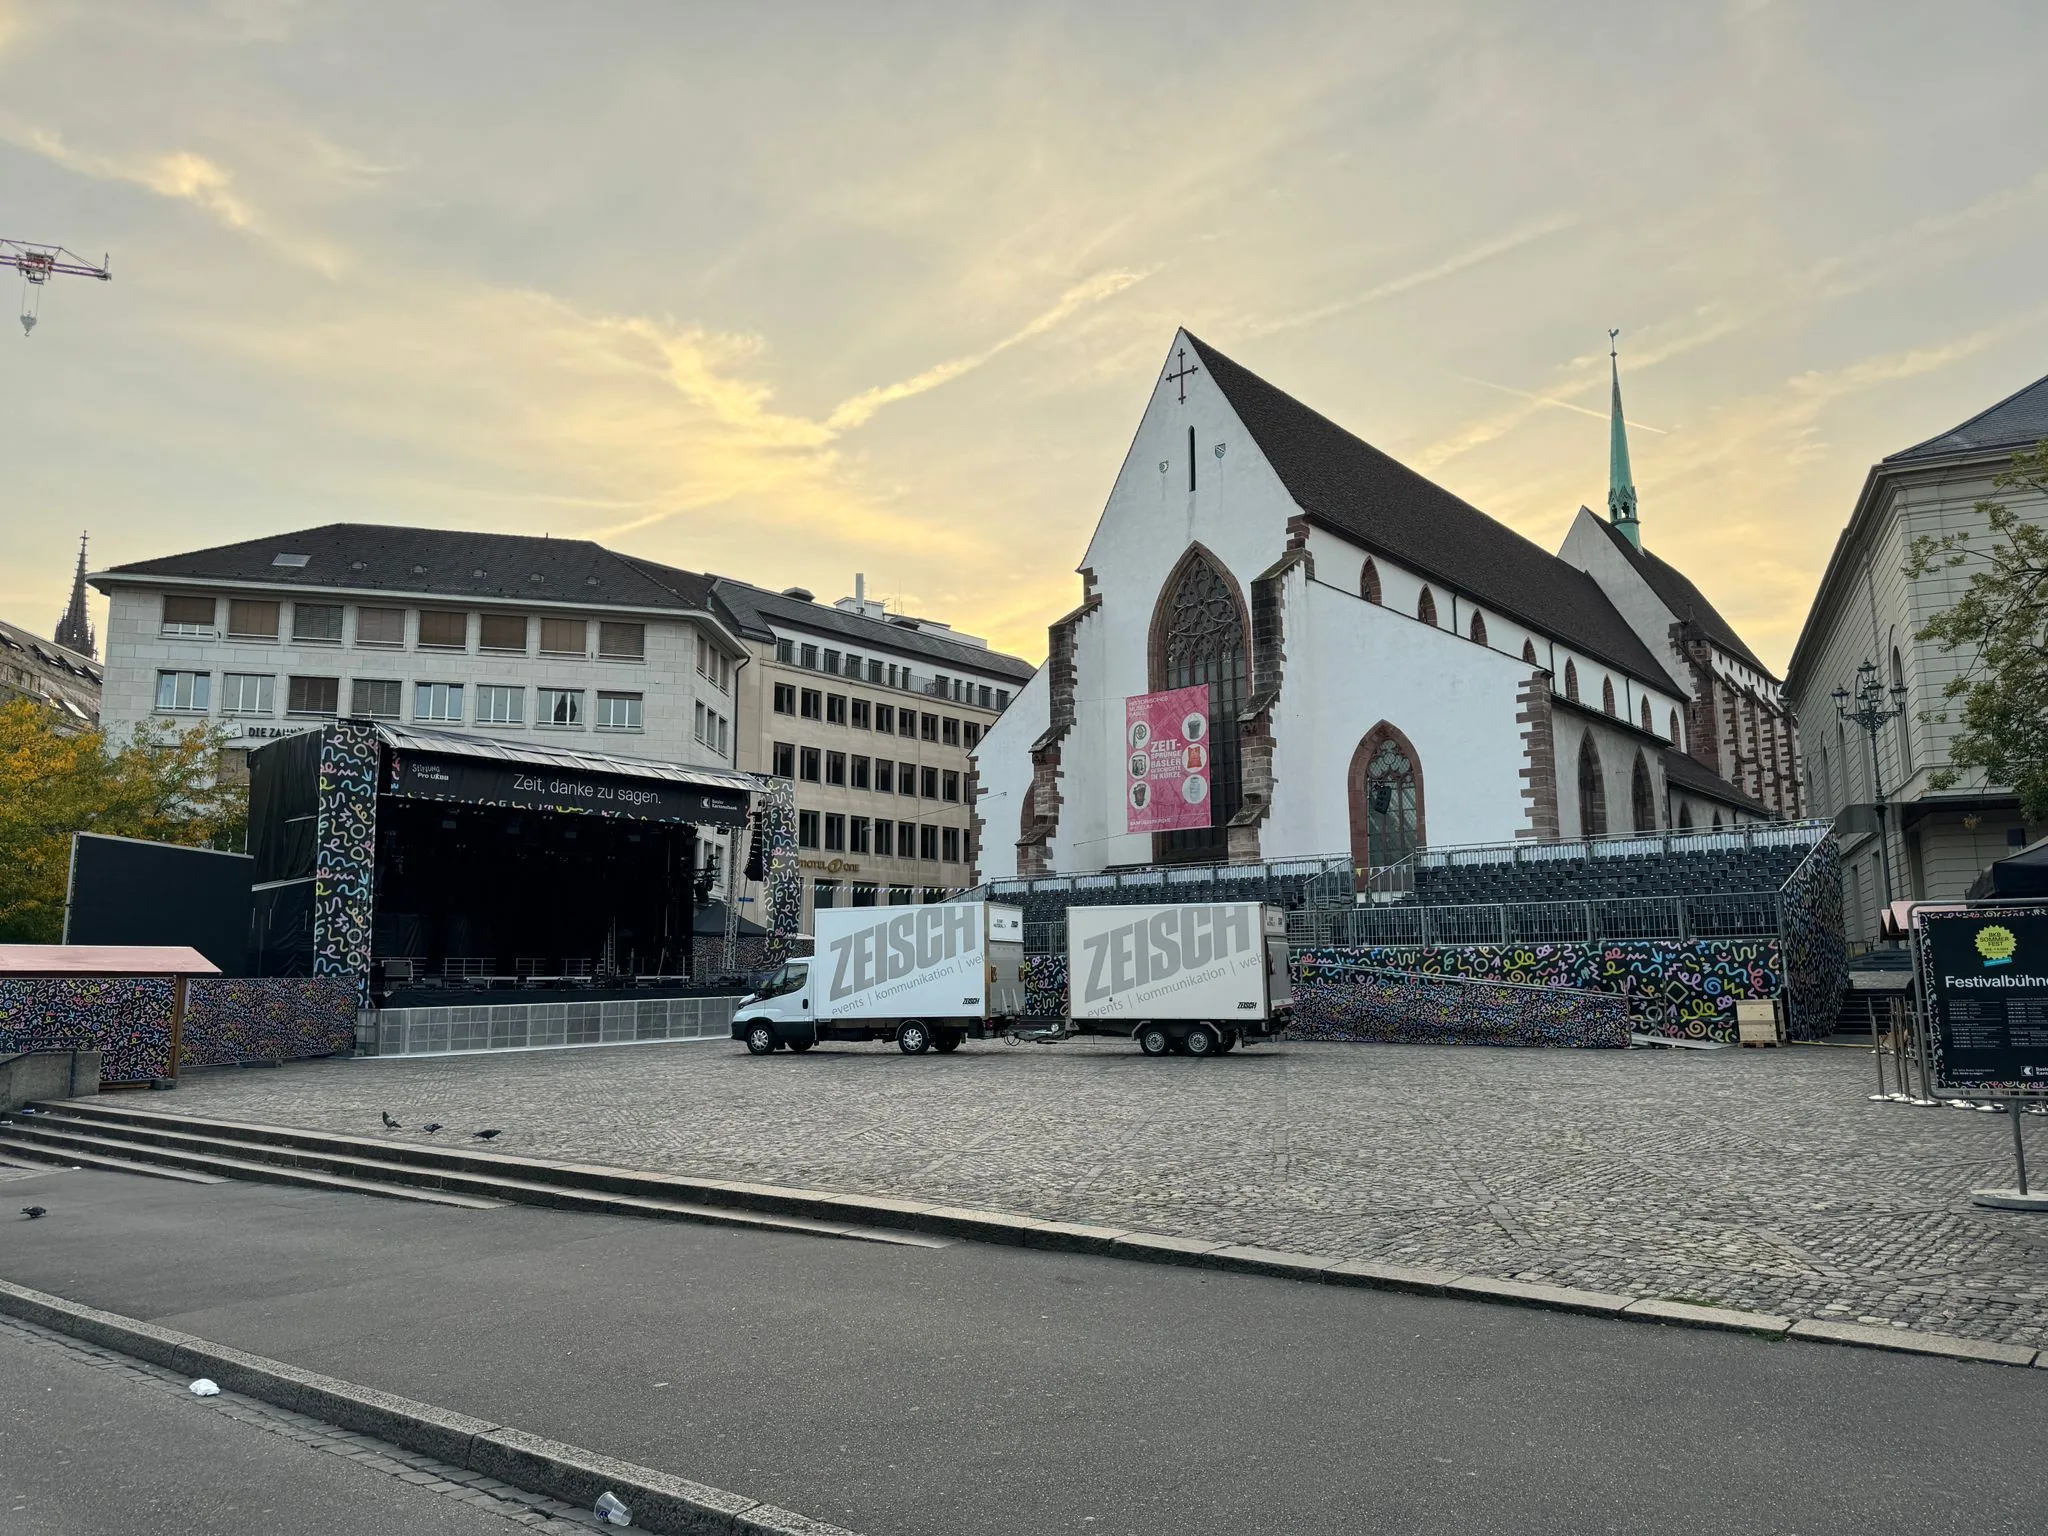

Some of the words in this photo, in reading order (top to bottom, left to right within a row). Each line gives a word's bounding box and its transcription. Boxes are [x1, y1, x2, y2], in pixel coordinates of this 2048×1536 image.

[248, 727, 267, 737] DIE
[1151, 739, 1181, 753] ZEIT-
[513, 773, 545, 794] Zeit,
[550, 779, 594, 797] danke
[597, 786, 614, 799] zu
[617, 788, 662, 805] sagen.
[830, 906, 976, 1002] ZEISCH
[1083, 906, 1250, 1004] ZEISCH
[832, 999, 865, 1015] events
[875, 965, 954, 1001] kommunikation
[1087, 998, 1124, 1017] events
[1136, 965, 1226, 1004] kommunikation
[1236, 1001, 1257, 1010] ZEISCH
